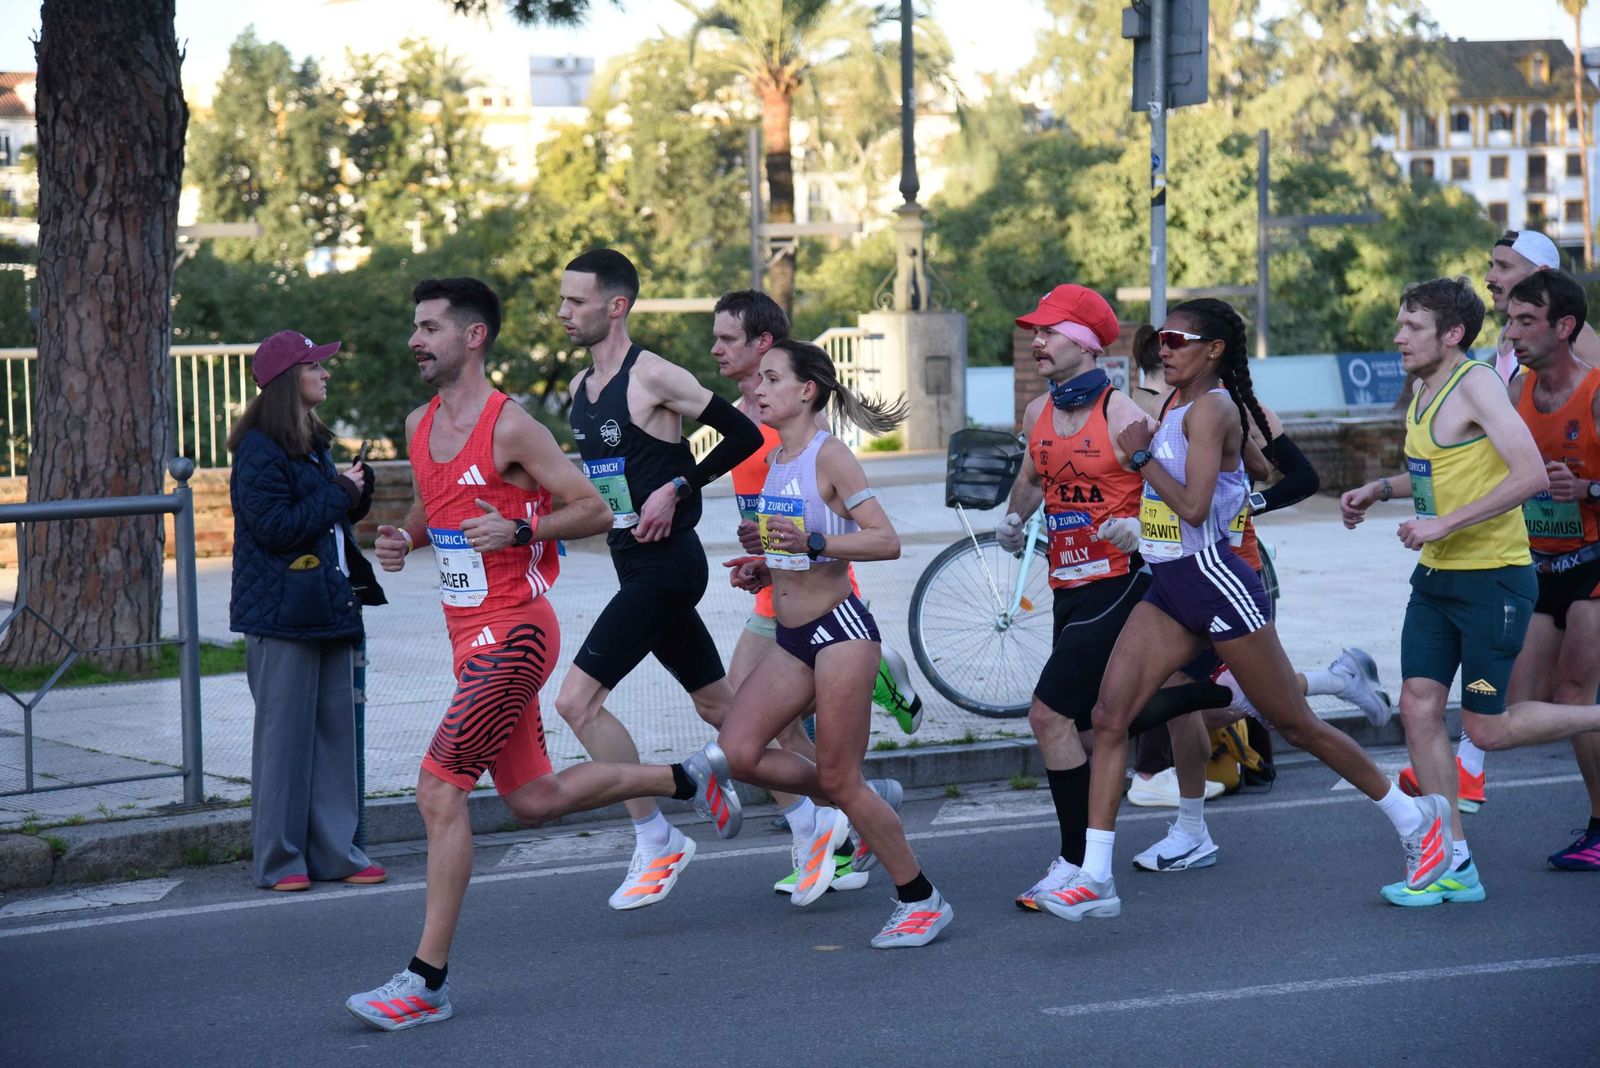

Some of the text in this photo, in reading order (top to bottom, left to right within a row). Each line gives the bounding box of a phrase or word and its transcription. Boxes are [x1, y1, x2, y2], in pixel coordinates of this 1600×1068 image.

[591, 463, 618, 474] ZURICH
[600, 485, 609, 494] 557
[609, 498, 621, 511] EX
[768, 501, 793, 512] ZURICH
[1058, 515, 1085, 526] ZURICH
[434, 534, 468, 544] ZURICH
[1065, 536, 1074, 546] 791
[1059, 547, 1089, 565] WILLY
[443, 557, 449, 567] 47
[1551, 553, 1580, 573] MAX
